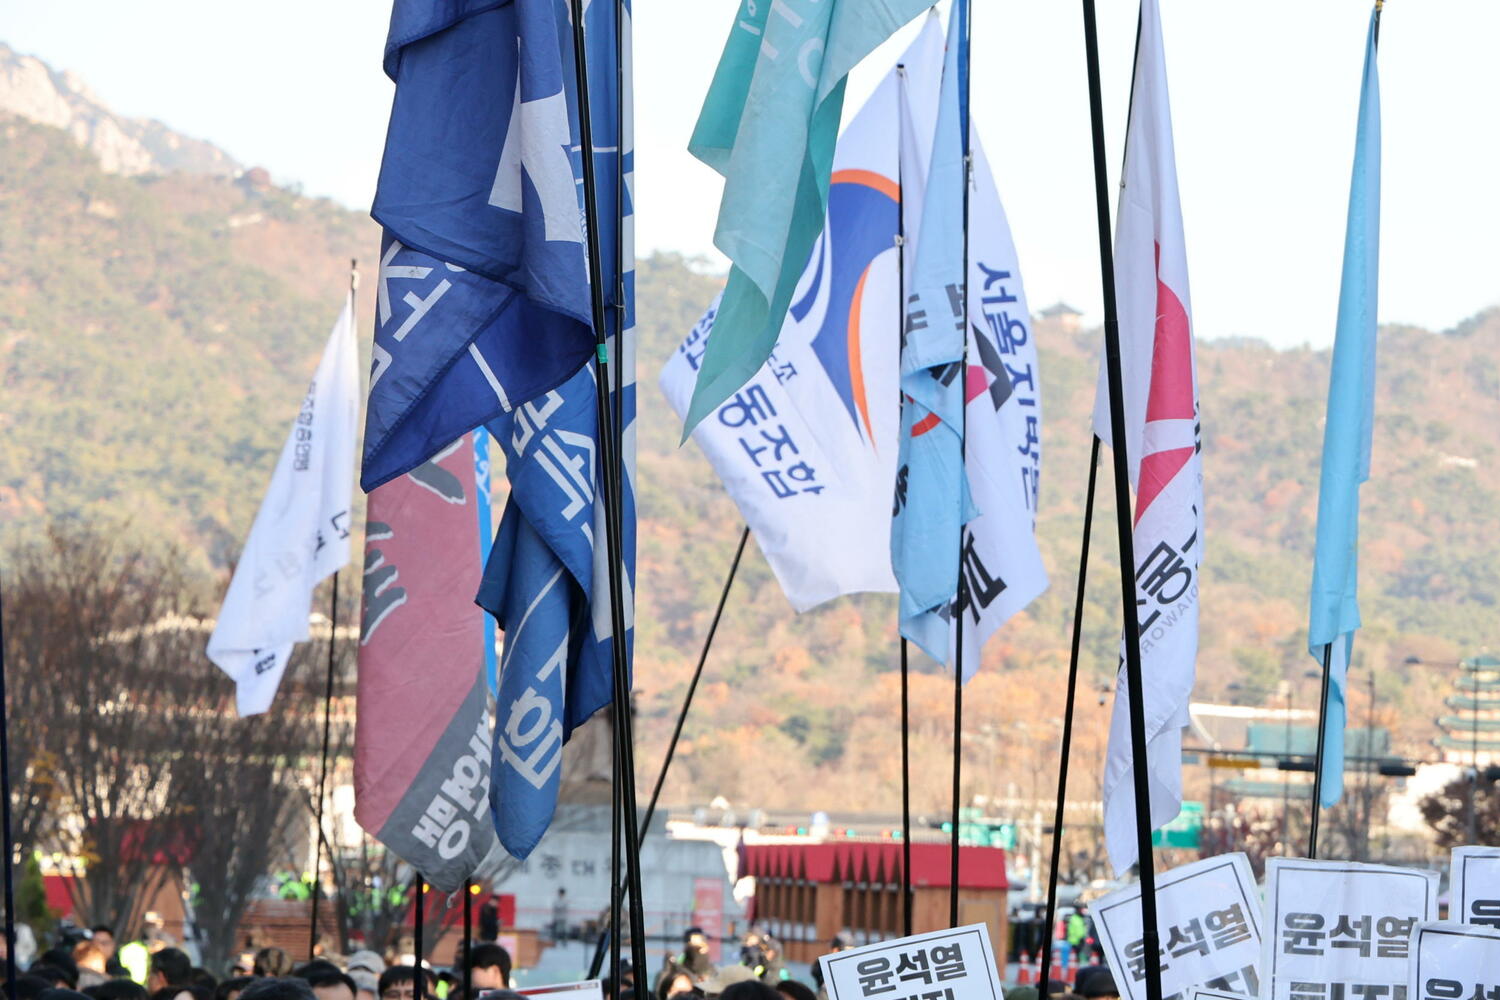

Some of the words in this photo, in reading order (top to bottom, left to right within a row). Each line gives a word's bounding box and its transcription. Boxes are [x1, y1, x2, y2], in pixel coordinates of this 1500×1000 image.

[1122, 902, 1252, 982] 윤석열
[1283, 912, 1419, 959] 윤석열
[857, 942, 967, 997] 윤석열
